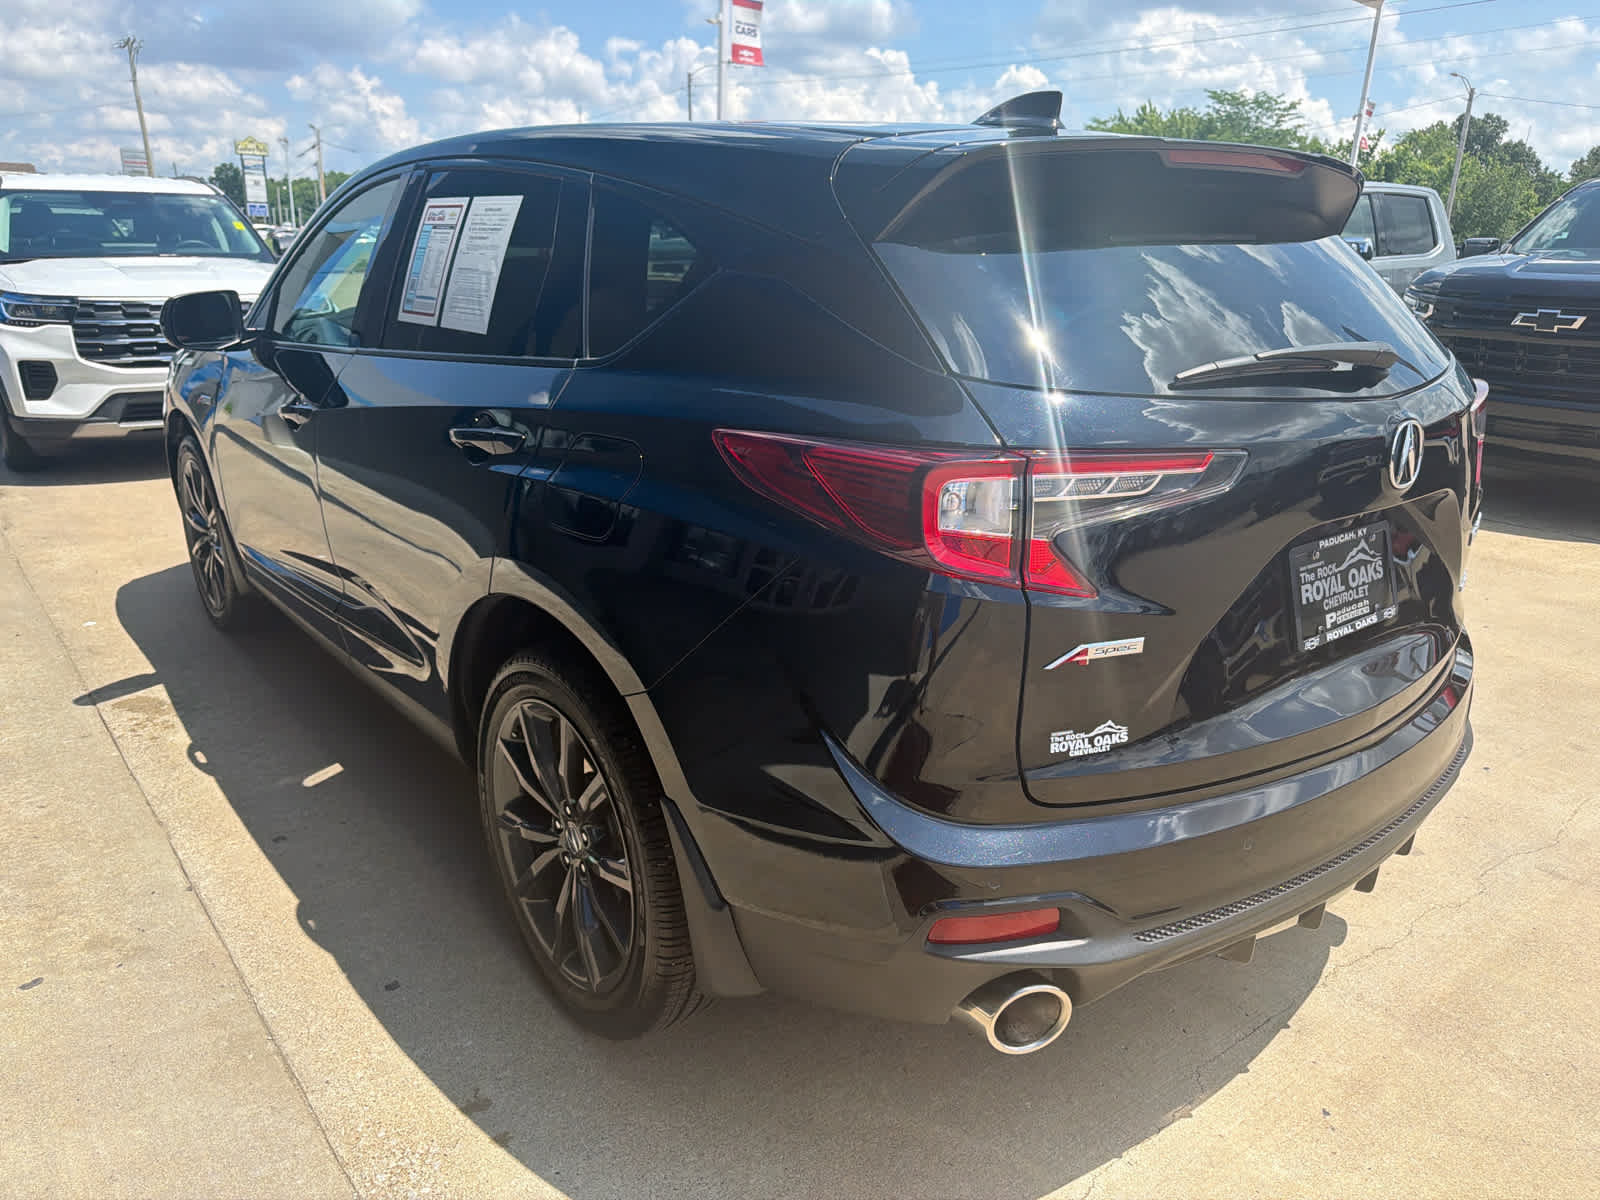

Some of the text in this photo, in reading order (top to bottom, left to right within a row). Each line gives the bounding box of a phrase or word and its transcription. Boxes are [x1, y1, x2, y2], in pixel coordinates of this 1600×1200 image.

[1358, 527, 1368, 538] KY
[1300, 571, 1316, 585] The
[1301, 560, 1385, 605] ROYAL OAKS
[1323, 584, 1370, 611] CHEVROLET
[1326, 623, 1355, 641] ROYAL
[1356, 614, 1379, 630] OAKS
[1050, 731, 1129, 754] ROYAL OAKS
[1068, 744, 1111, 757] CHEVROLET
